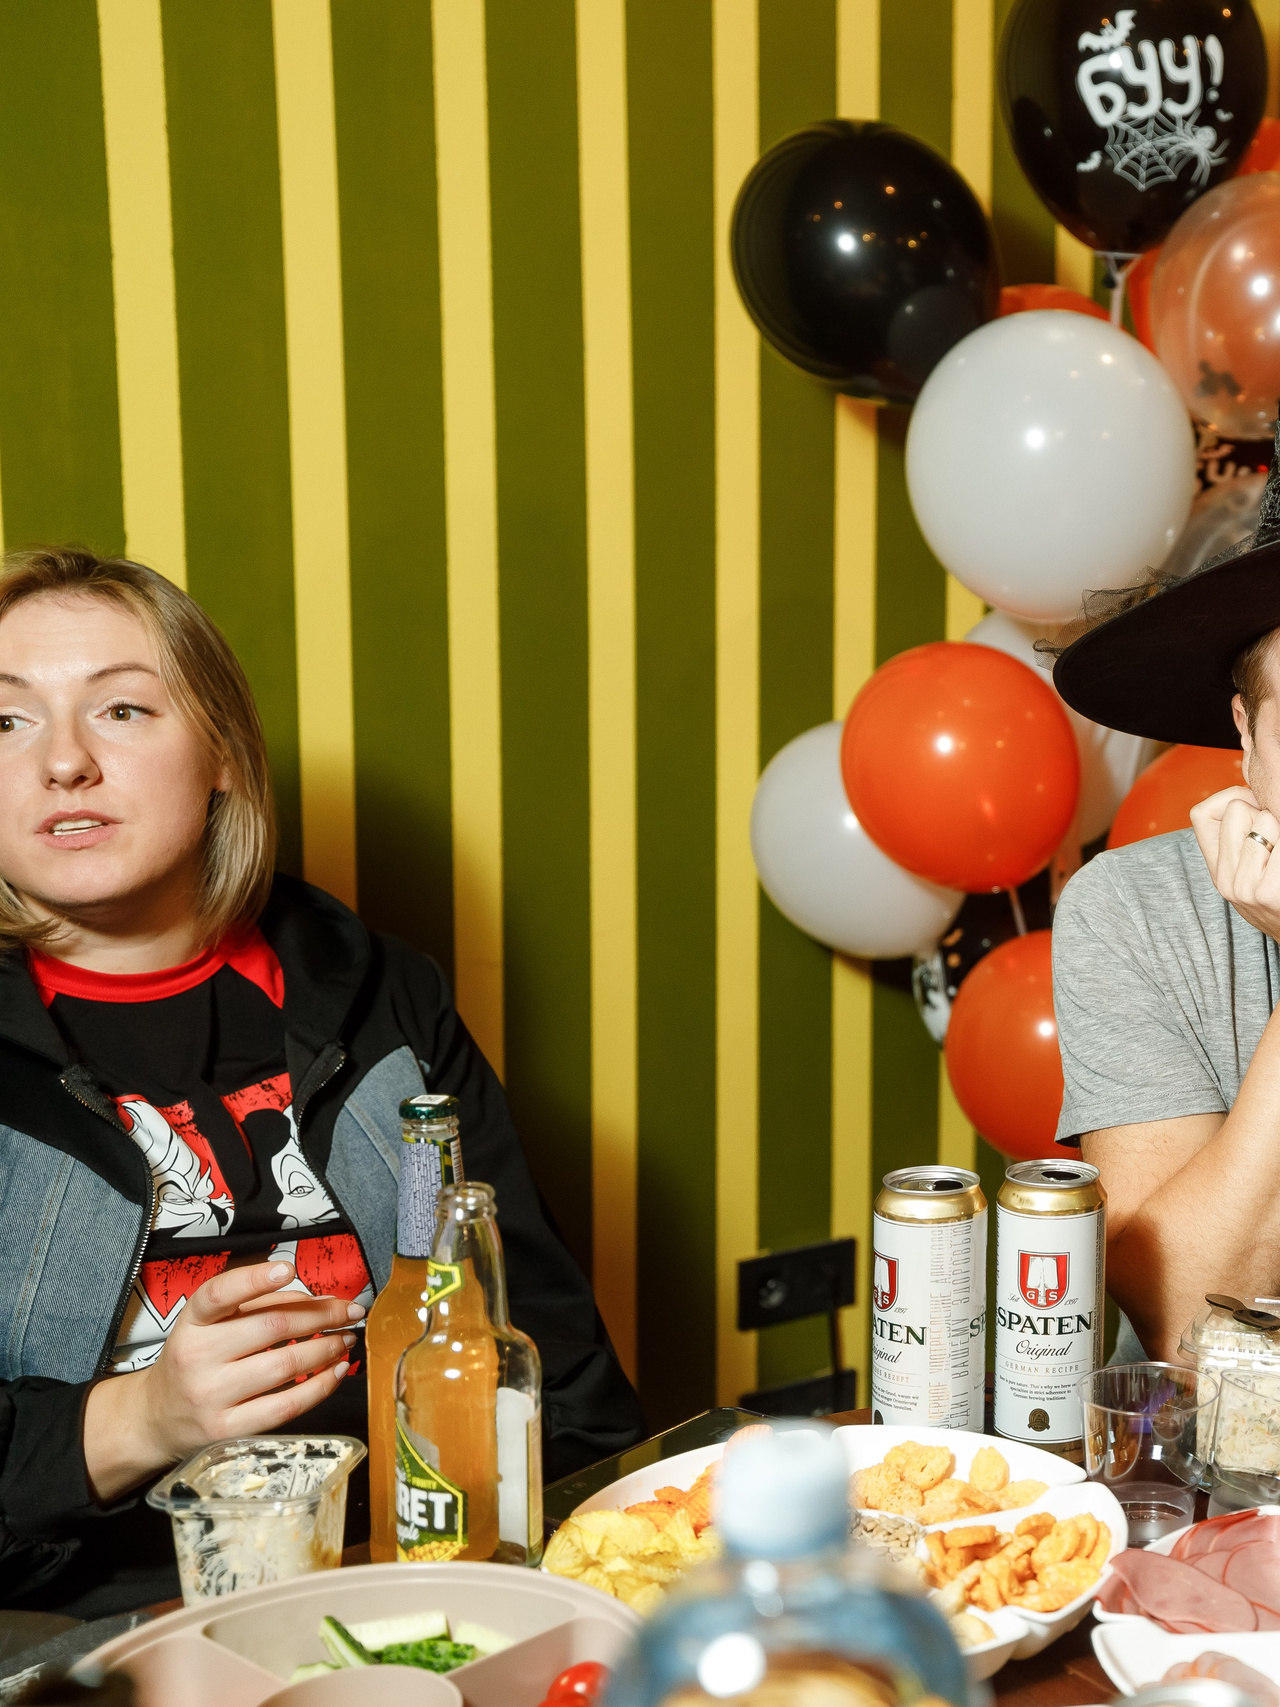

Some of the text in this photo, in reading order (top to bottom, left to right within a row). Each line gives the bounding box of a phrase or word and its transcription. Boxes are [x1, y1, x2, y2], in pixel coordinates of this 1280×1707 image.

[882, 1294, 890, 1305] S
[1026, 1290, 1058, 1301] G S
[873, 1313, 927, 1346] ATEN
[997, 1306, 1094, 1336] SPATEN
[873, 1343, 902, 1364] riginal
[1015, 1339, 1073, 1360] Original
[1005, 1361, 1079, 1374] GERMAN RECIPE
[396, 1480, 453, 1530] RET
